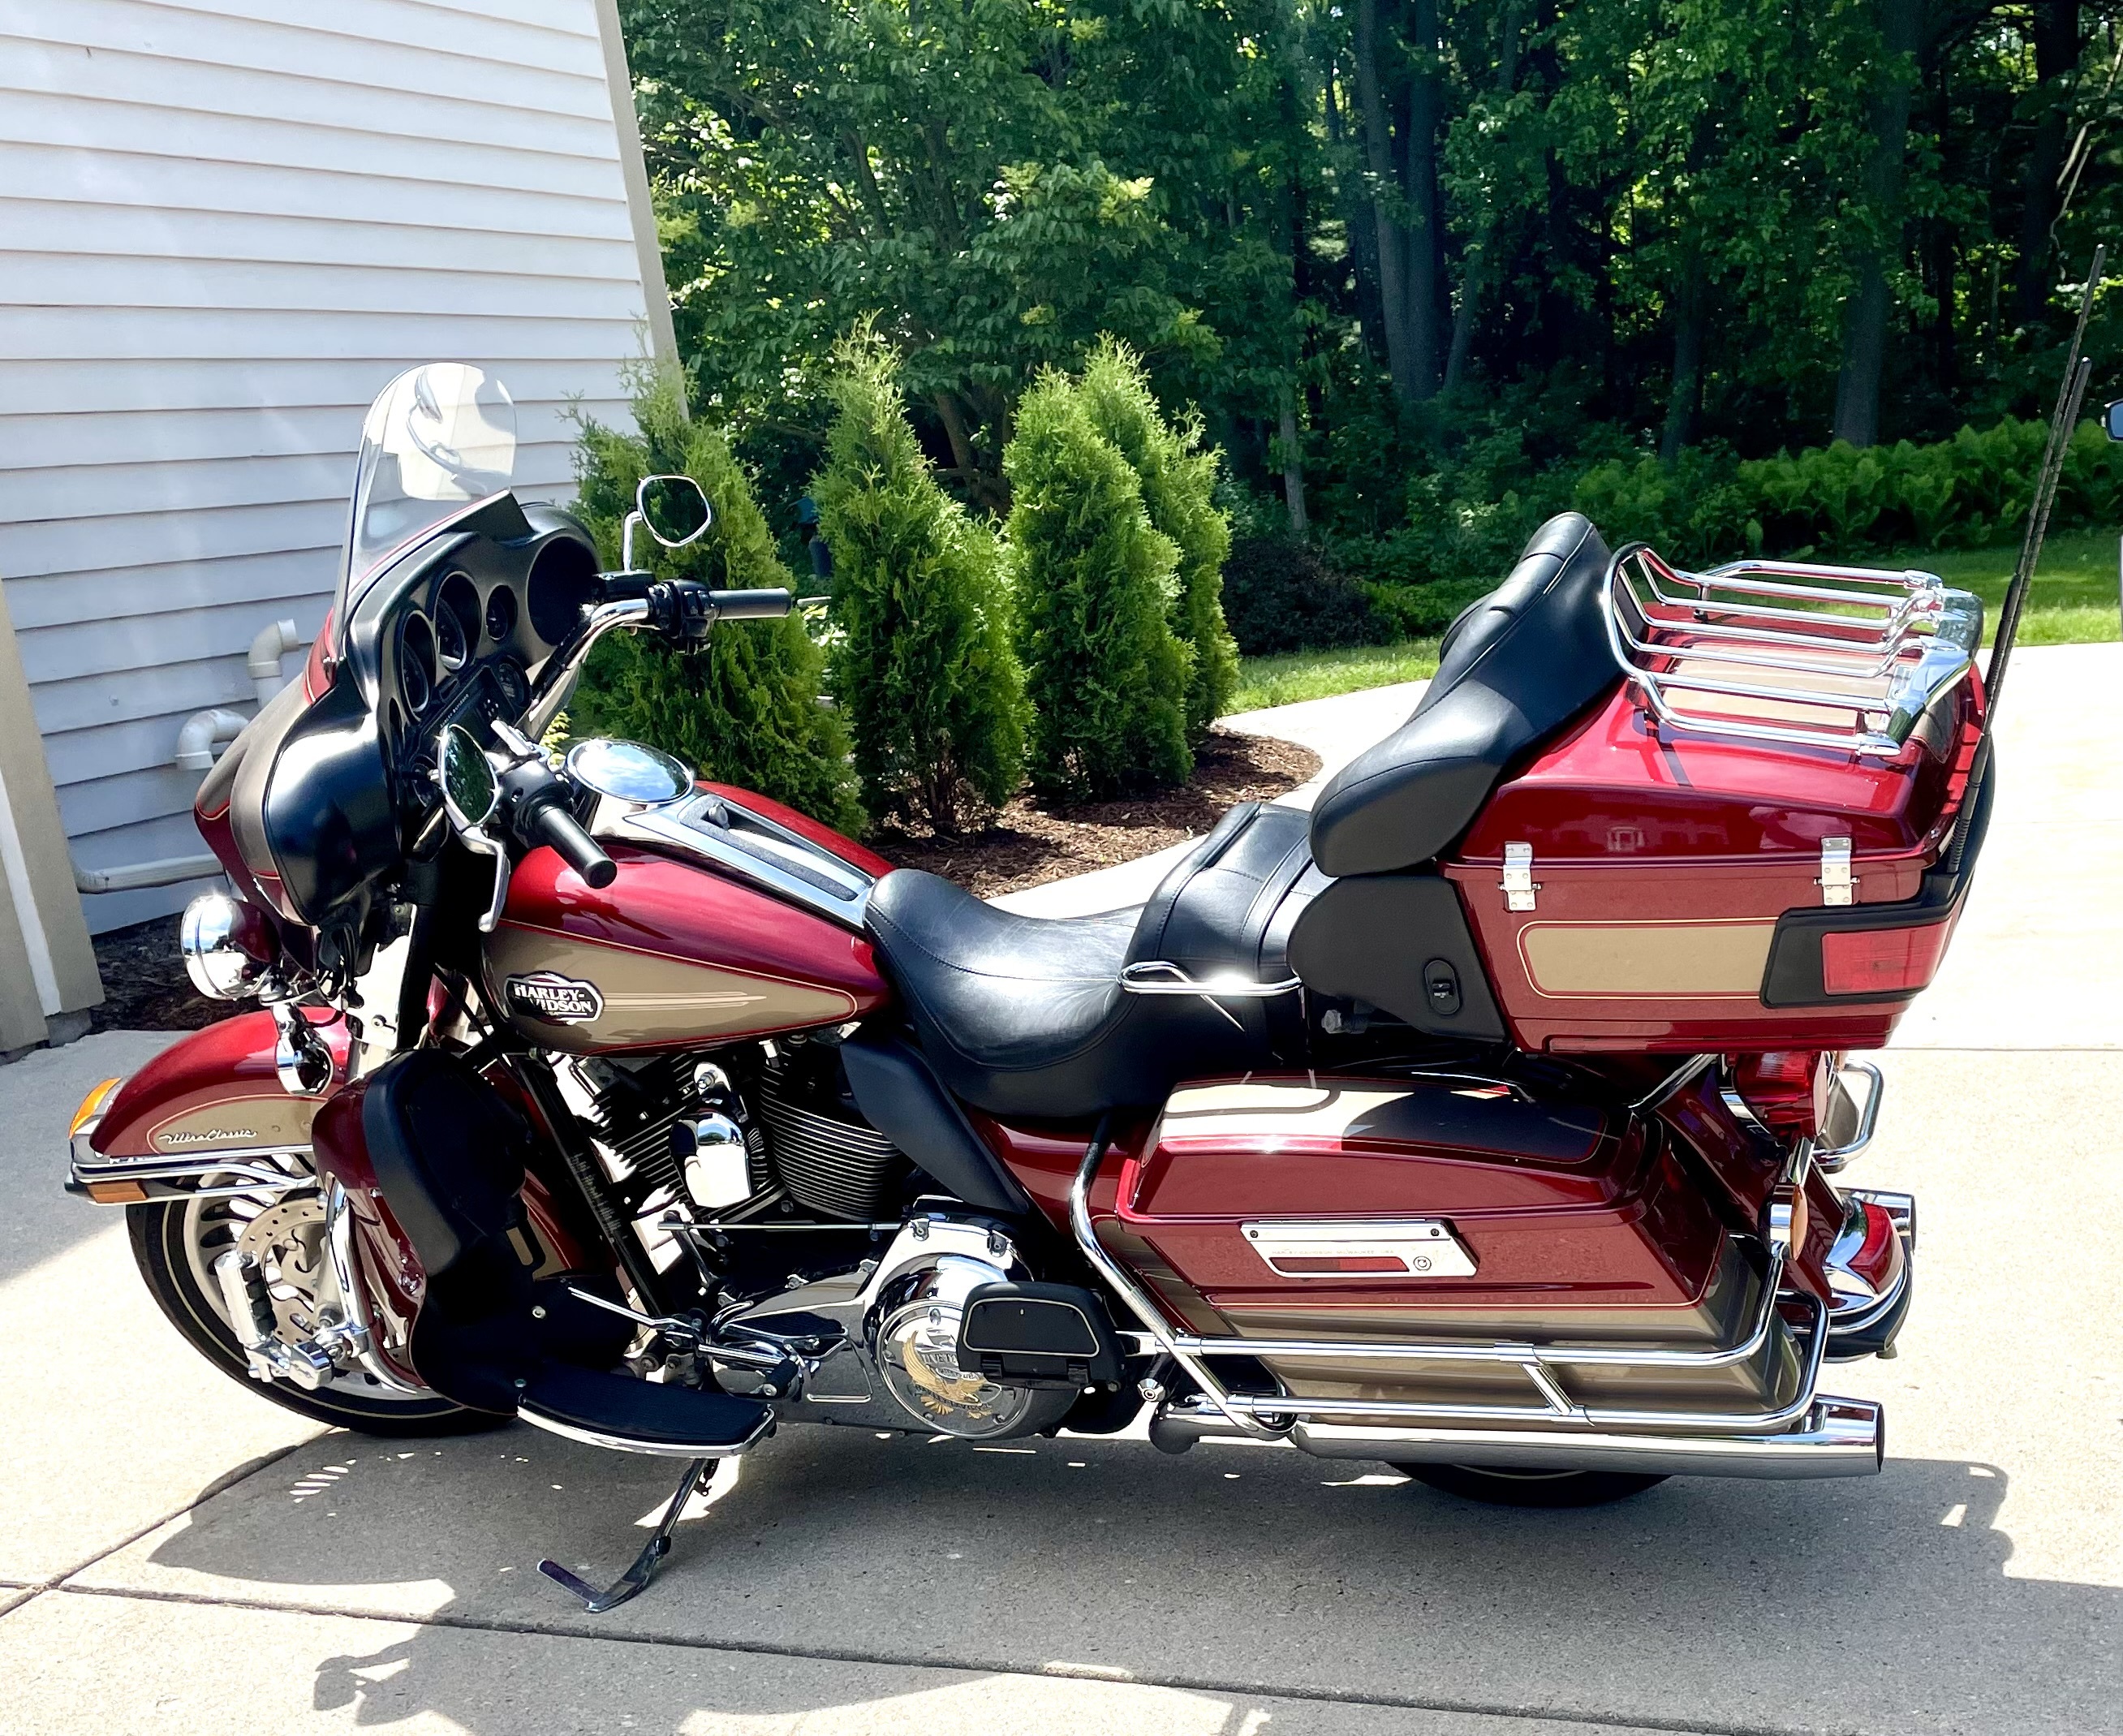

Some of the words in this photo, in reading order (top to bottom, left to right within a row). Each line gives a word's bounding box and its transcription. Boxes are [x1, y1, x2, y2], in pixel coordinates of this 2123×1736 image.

[514, 984, 584, 1001] HARLEY-
[520, 997, 594, 1013] VIDSON
[158, 1132, 206, 1145] Ultra
[206, 1129, 257, 1141] Classic
